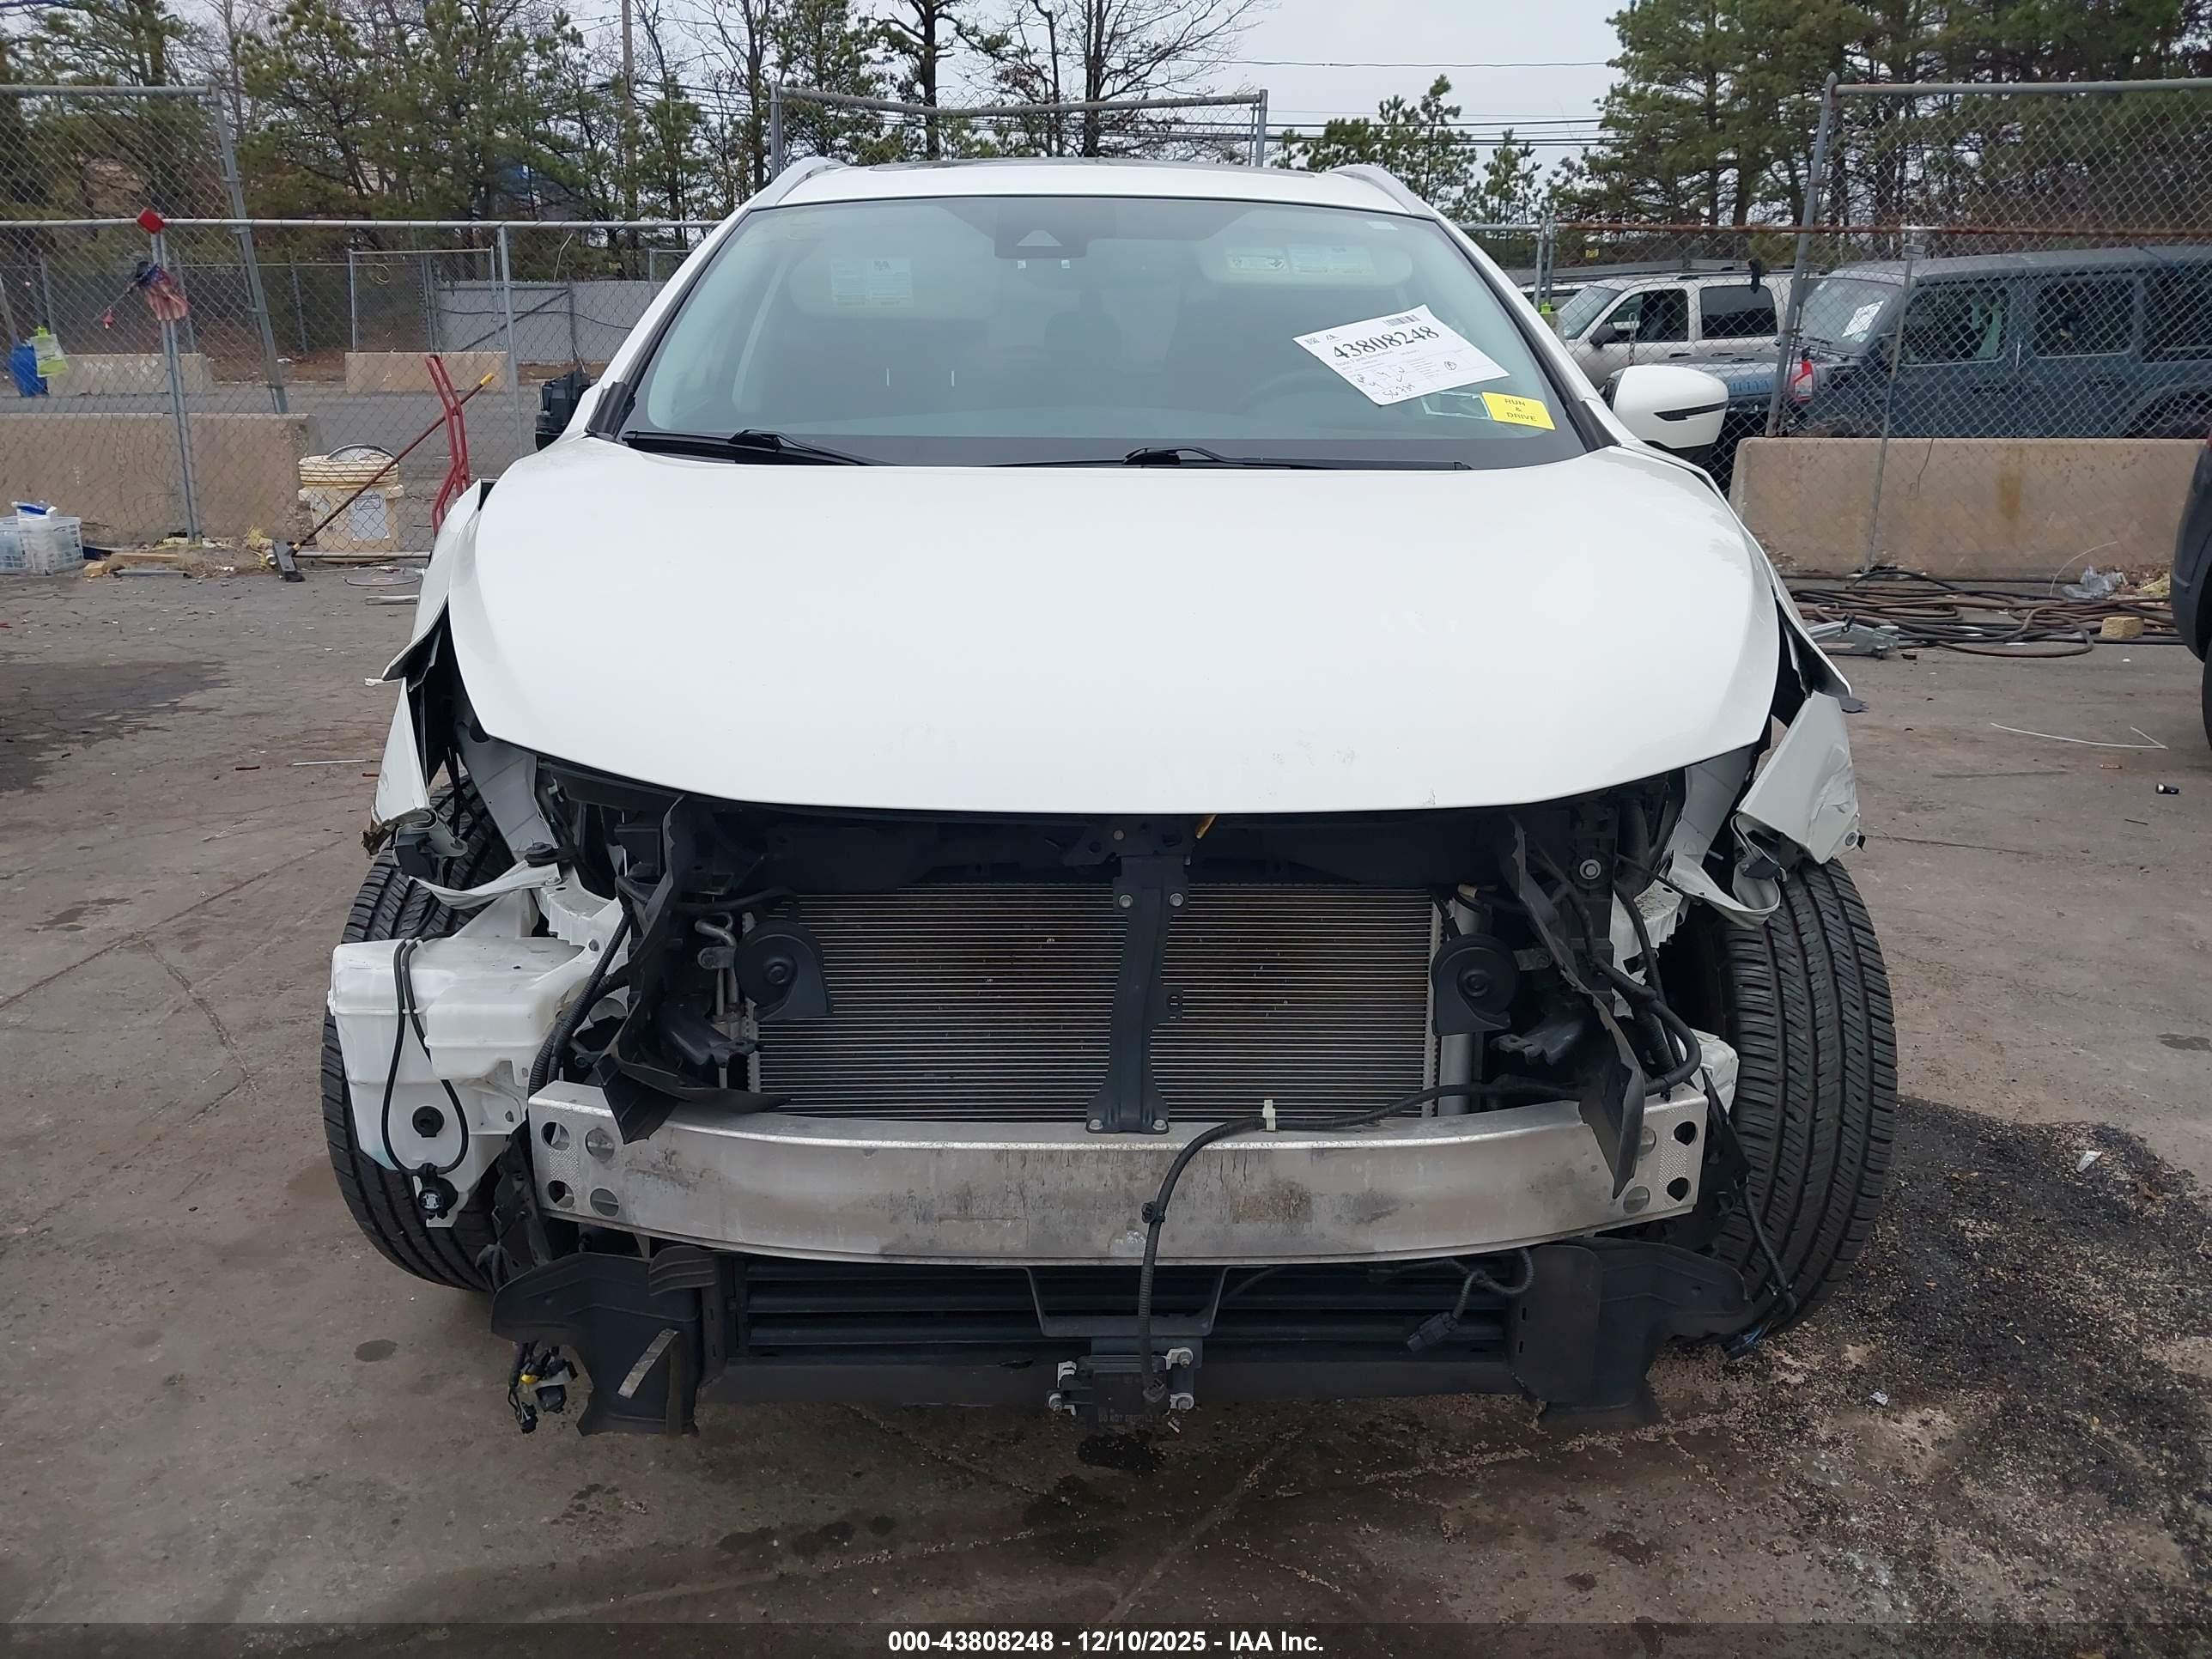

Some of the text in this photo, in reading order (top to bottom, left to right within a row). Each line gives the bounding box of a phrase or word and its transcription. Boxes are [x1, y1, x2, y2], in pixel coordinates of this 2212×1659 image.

[1333, 325, 1440, 359] 43808248
[1504, 398, 1526, 407] RUN
[1506, 412, 1539, 422] DRIVE
